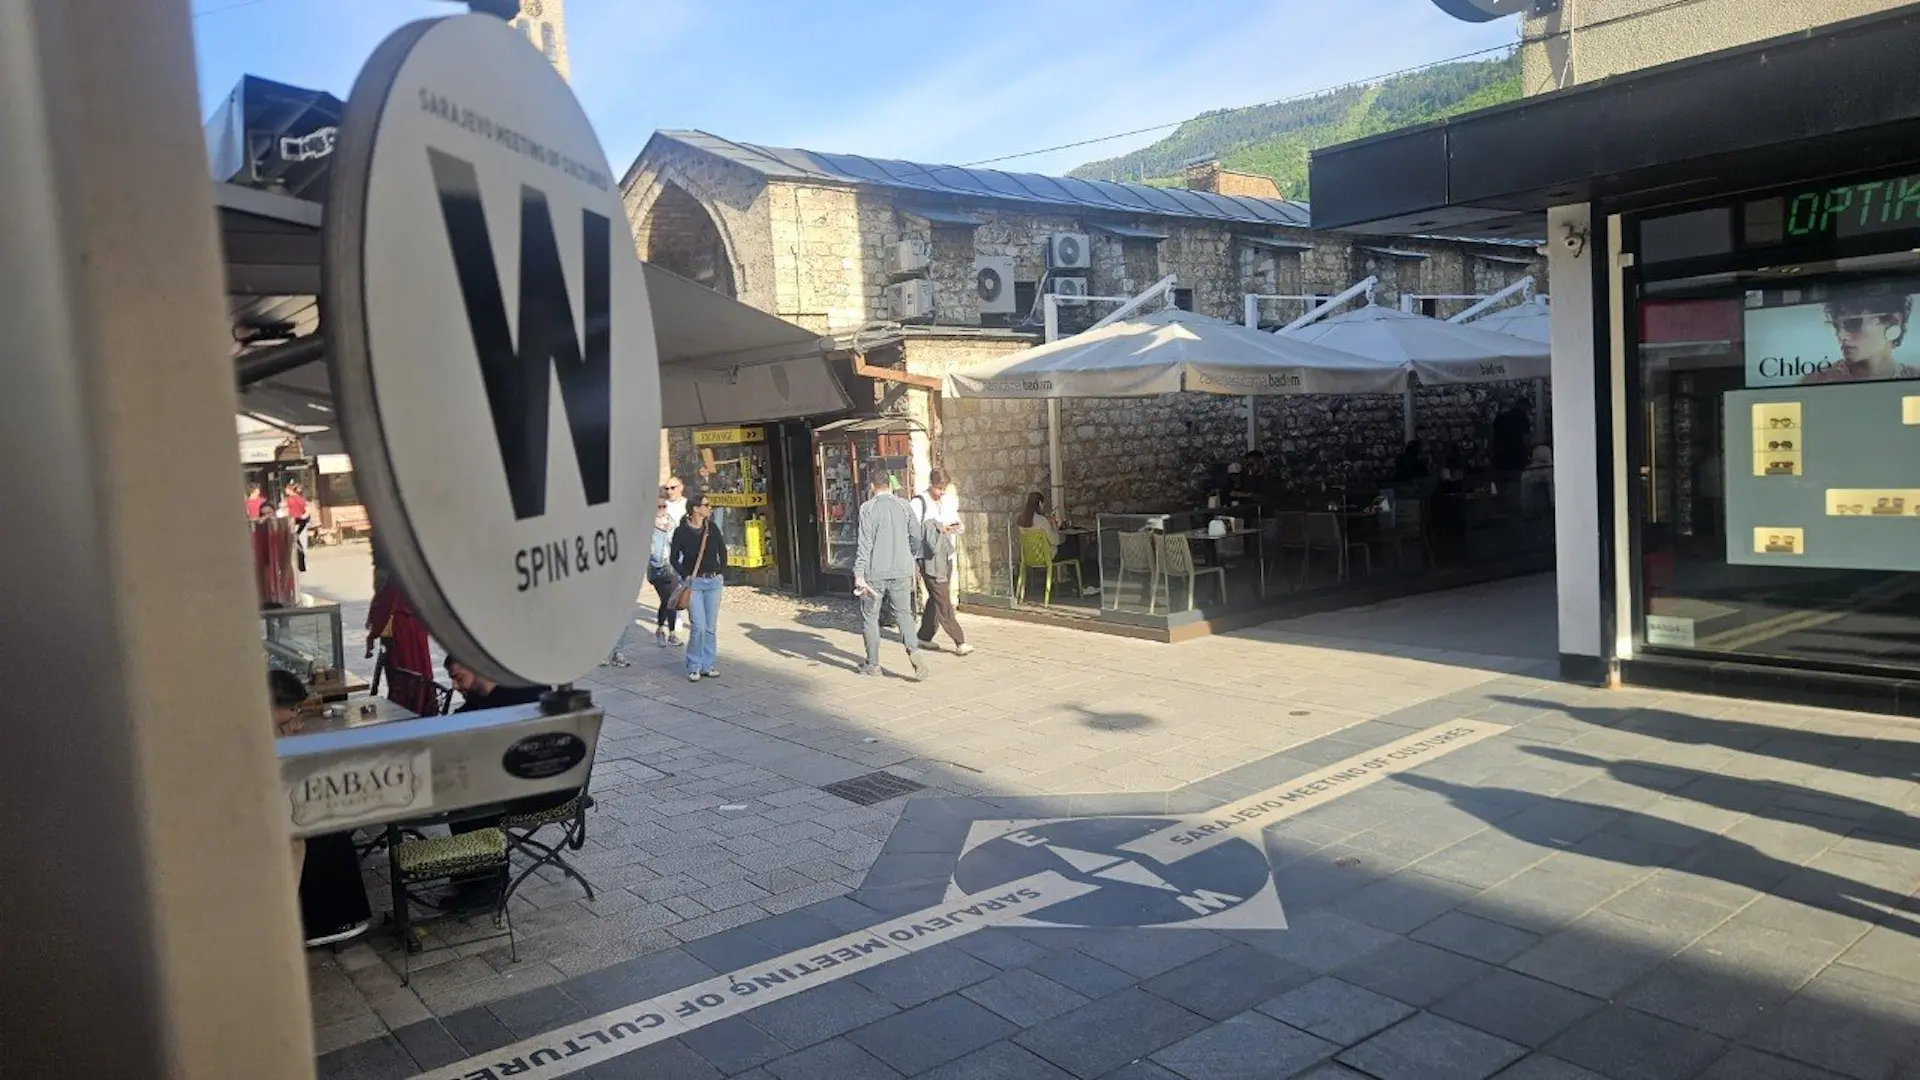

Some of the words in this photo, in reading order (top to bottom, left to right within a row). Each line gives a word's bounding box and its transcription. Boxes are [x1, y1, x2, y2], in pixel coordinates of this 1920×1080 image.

[418, 87, 492, 139] SARAJEVO
[426, 146, 611, 521] W
[1759, 356, 1832, 378] Chloé
[515, 538, 569, 592] SPIN
[576, 535, 590, 572] &
[594, 528, 618, 566] GO
[304, 763, 405, 802] EMBAG
[1170, 800, 1285, 846] SARAJEVO
[1278, 767, 1368, 802] MEETING
[1362, 757, 1391, 771] OF
[1387, 726, 1475, 760] CULTURES
[888, 887, 1041, 941] SARAJEVO
[729, 938, 888, 997] MEETING
[675, 994, 725, 1018] OF
[450, 1013, 666, 1080] CULTURE
